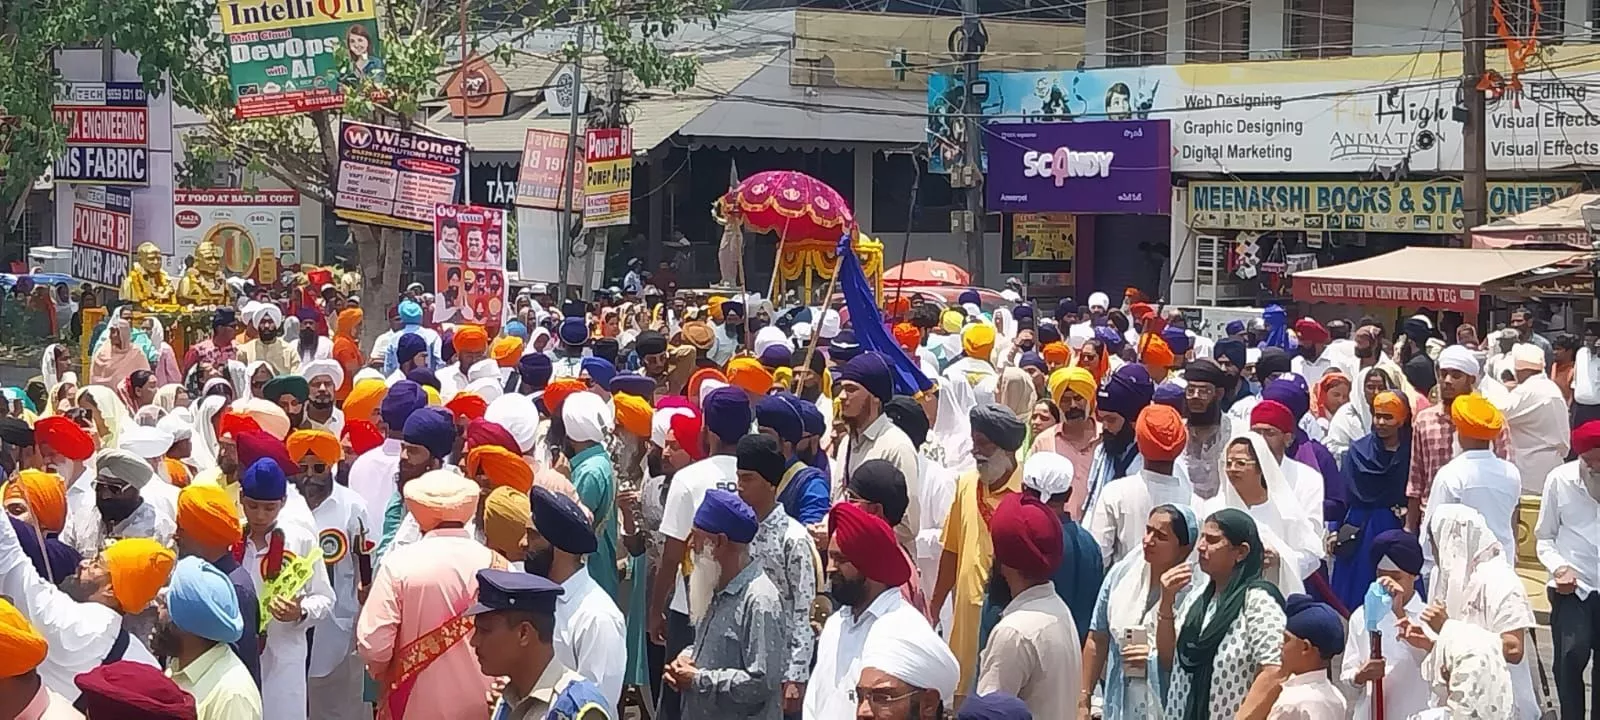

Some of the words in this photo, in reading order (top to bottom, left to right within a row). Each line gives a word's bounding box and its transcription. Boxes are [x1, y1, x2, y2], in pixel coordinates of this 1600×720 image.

[230, 33, 258, 44] Multi
[260, 29, 291, 40] Cloud
[230, 37, 339, 63] DevOps
[265, 65, 288, 77] with
[291, 59, 315, 79] AI
[1184, 94, 1212, 109] Web
[1217, 93, 1282, 111] Designing
[1531, 83, 1586, 101] Editing
[1375, 90, 1448, 128] High
[82, 111, 145, 140] ENGINEERING
[1183, 119, 1233, 137] Graphic
[1237, 118, 1303, 136] Designing
[1492, 112, 1539, 129] Visual
[1545, 112, 1600, 127] Effects
[375, 130, 462, 157] Wisionet
[381, 145, 426, 159] SOLUTIONS
[428, 153, 443, 162] PVT
[445, 156, 460, 164] LTD
[588, 132, 620, 159] Power
[621, 128, 633, 155] BI
[1183, 144, 1223, 162] Digital
[1227, 144, 1292, 161] Marketing
[1491, 140, 1538, 156] Visual
[1544, 140, 1599, 156] Effects
[56, 147, 80, 177] MS
[86, 148, 144, 178] FABRIC
[1024, 147, 1114, 187] SCANDY
[587, 166, 611, 186] Power
[612, 163, 630, 186] Apps
[188, 194, 216, 202] FOOD
[217, 194, 230, 202] AT
[270, 194, 294, 202] COST
[1194, 185, 1310, 213] MEENAKSHI
[1317, 186, 1392, 214] BOOKS
[1399, 186, 1415, 214] &
[74, 207, 115, 248] POWER
[117, 216, 129, 251] BI
[72, 246, 103, 282] POWER
[103, 252, 128, 287] APPS
[1310, 282, 1344, 297] GANESH
[1346, 284, 1373, 299] TIFFIN
[1375, 285, 1408, 301] CENTER
[1411, 287, 1435, 302] PURE
[1437, 288, 1457, 304] VEG
